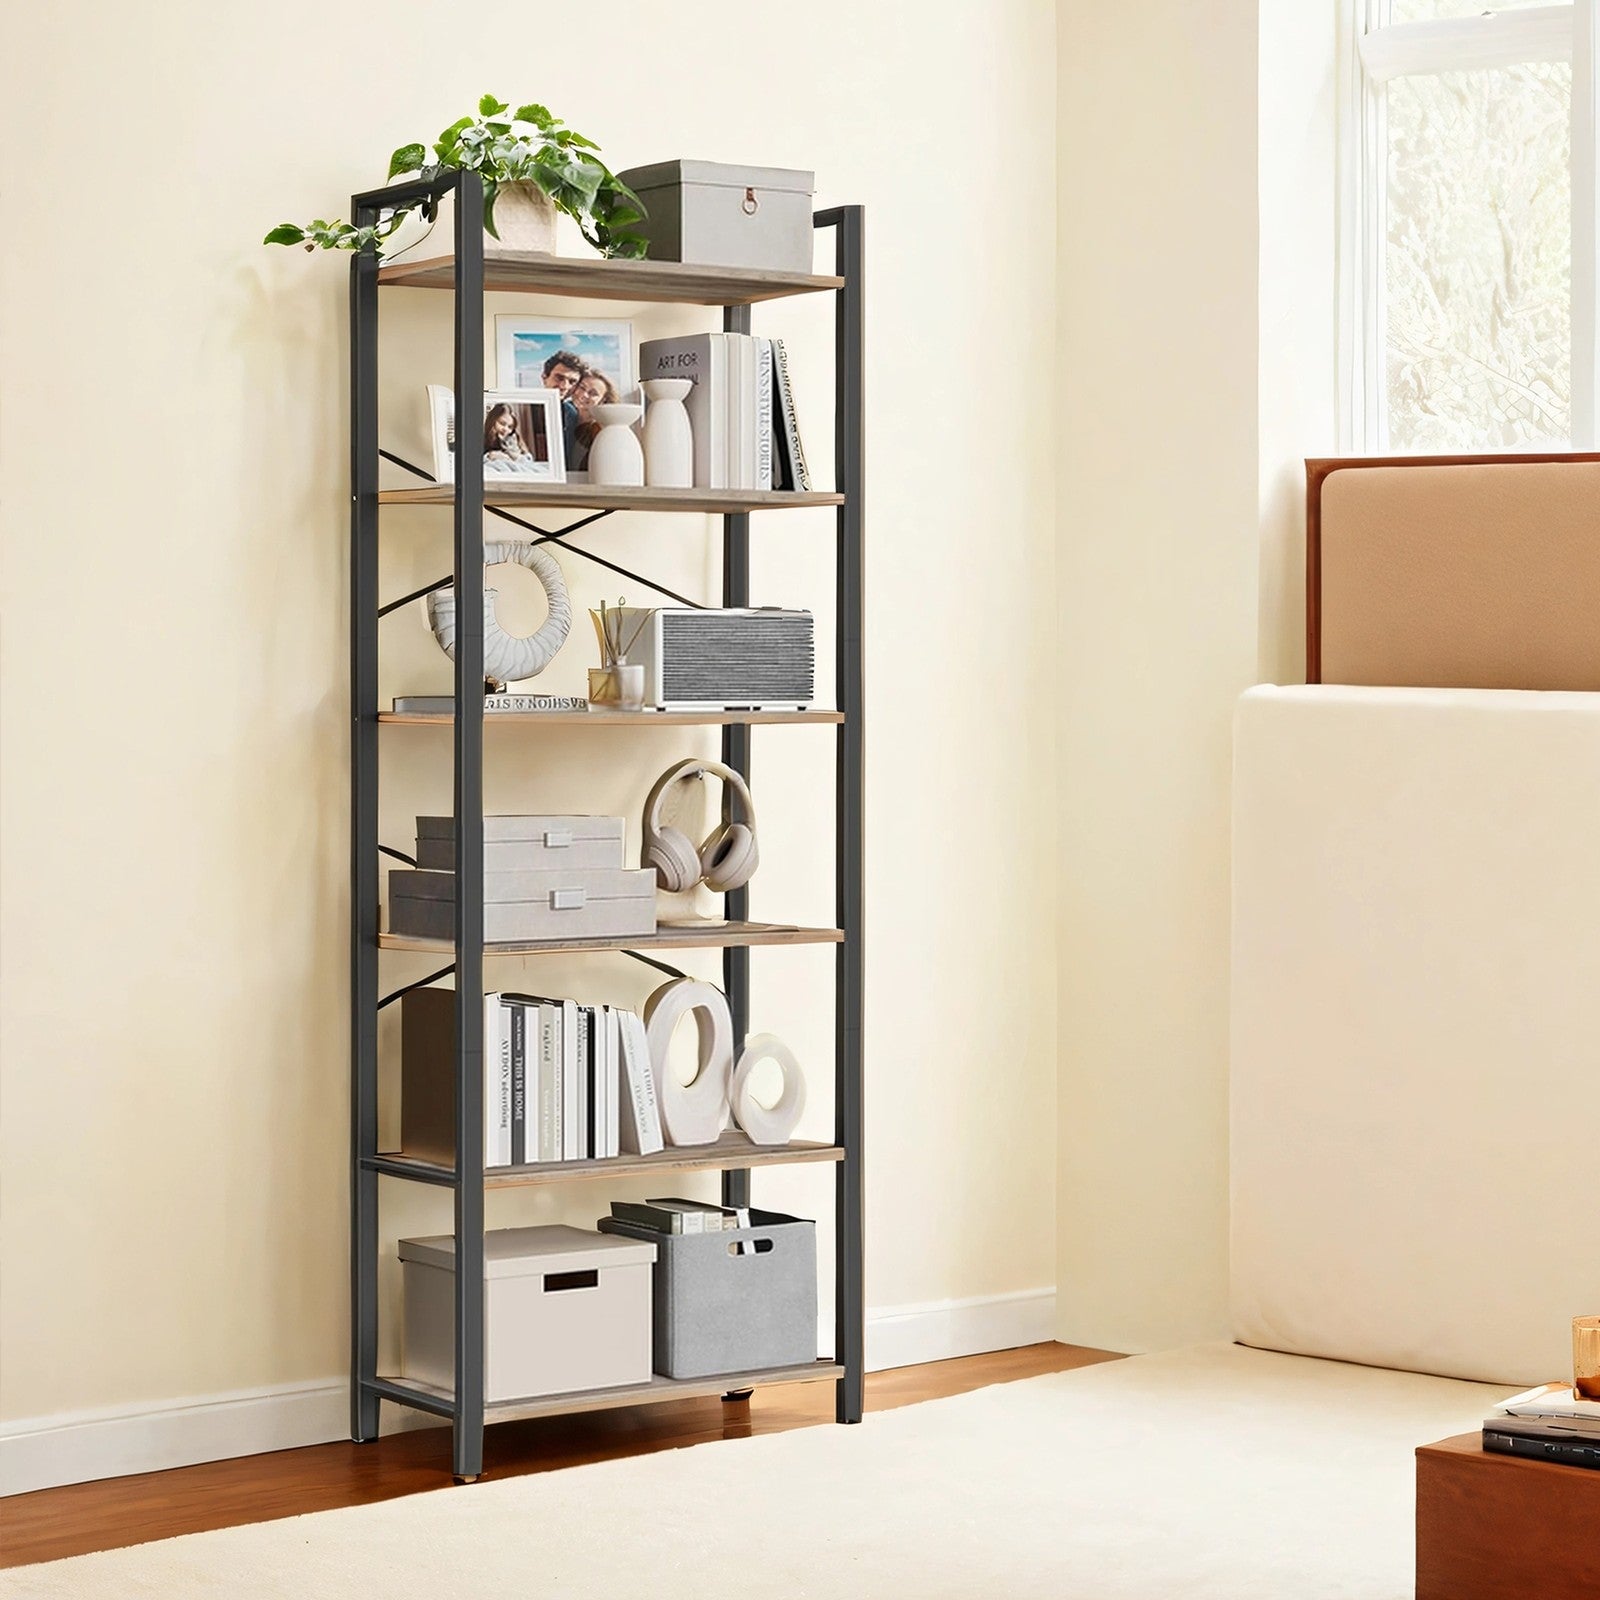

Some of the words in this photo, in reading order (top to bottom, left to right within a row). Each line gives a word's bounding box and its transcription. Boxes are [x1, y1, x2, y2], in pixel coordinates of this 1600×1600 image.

[657, 355, 675, 369] ART
[678, 352, 698, 367] FOR
[759, 429, 769, 481] STORIES
[542, 1023, 550, 1062] England
[514, 1055, 523, 1078] THIS
[514, 1079, 523, 1089] IS
[514, 1090, 523, 1120] HOME
